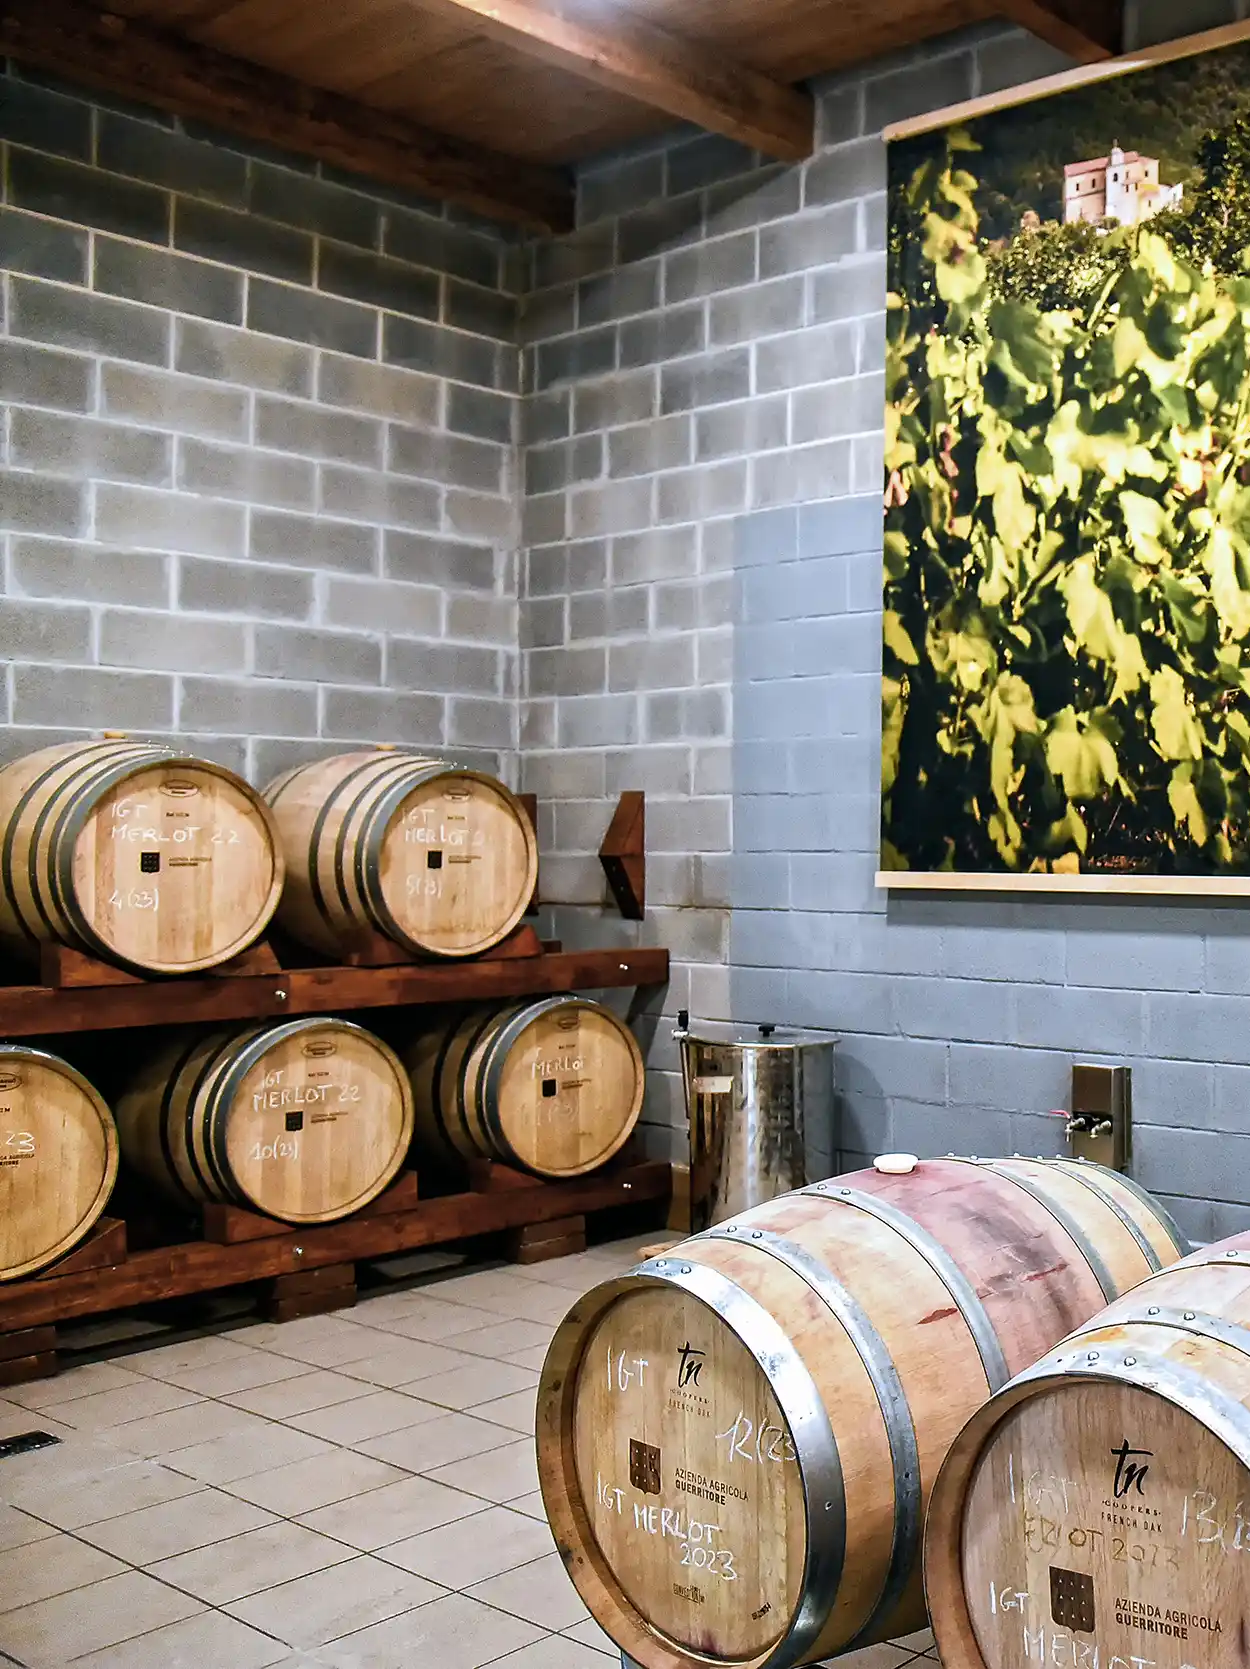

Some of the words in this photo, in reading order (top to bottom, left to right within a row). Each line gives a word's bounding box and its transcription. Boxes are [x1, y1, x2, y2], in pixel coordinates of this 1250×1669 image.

[111, 798, 148, 819] IGT
[110, 823, 201, 843] MERLOT
[253, 1084, 333, 1113] MERLOT
[338, 1083, 362, 1102] 22
[607, 1344, 650, 1393] IGT
[596, 1470, 626, 1515] IGT
[675, 1467, 708, 1488] AZIENDA
[709, 1480, 749, 1501] AGRICOLA
[675, 1479, 727, 1506] GUERRITORE
[633, 1502, 722, 1545] MERLOT
[1100, 1511, 1138, 1529] FRENCH
[1143, 1521, 1163, 1533] OAK
[679, 1542, 738, 1581] 2023
[989, 1581, 1030, 1615] IGT
[1114, 1598, 1161, 1619] AZIENDA
[1164, 1609, 1222, 1633] AGRICOLA
[1115, 1613, 1189, 1640] GUERRITORE
